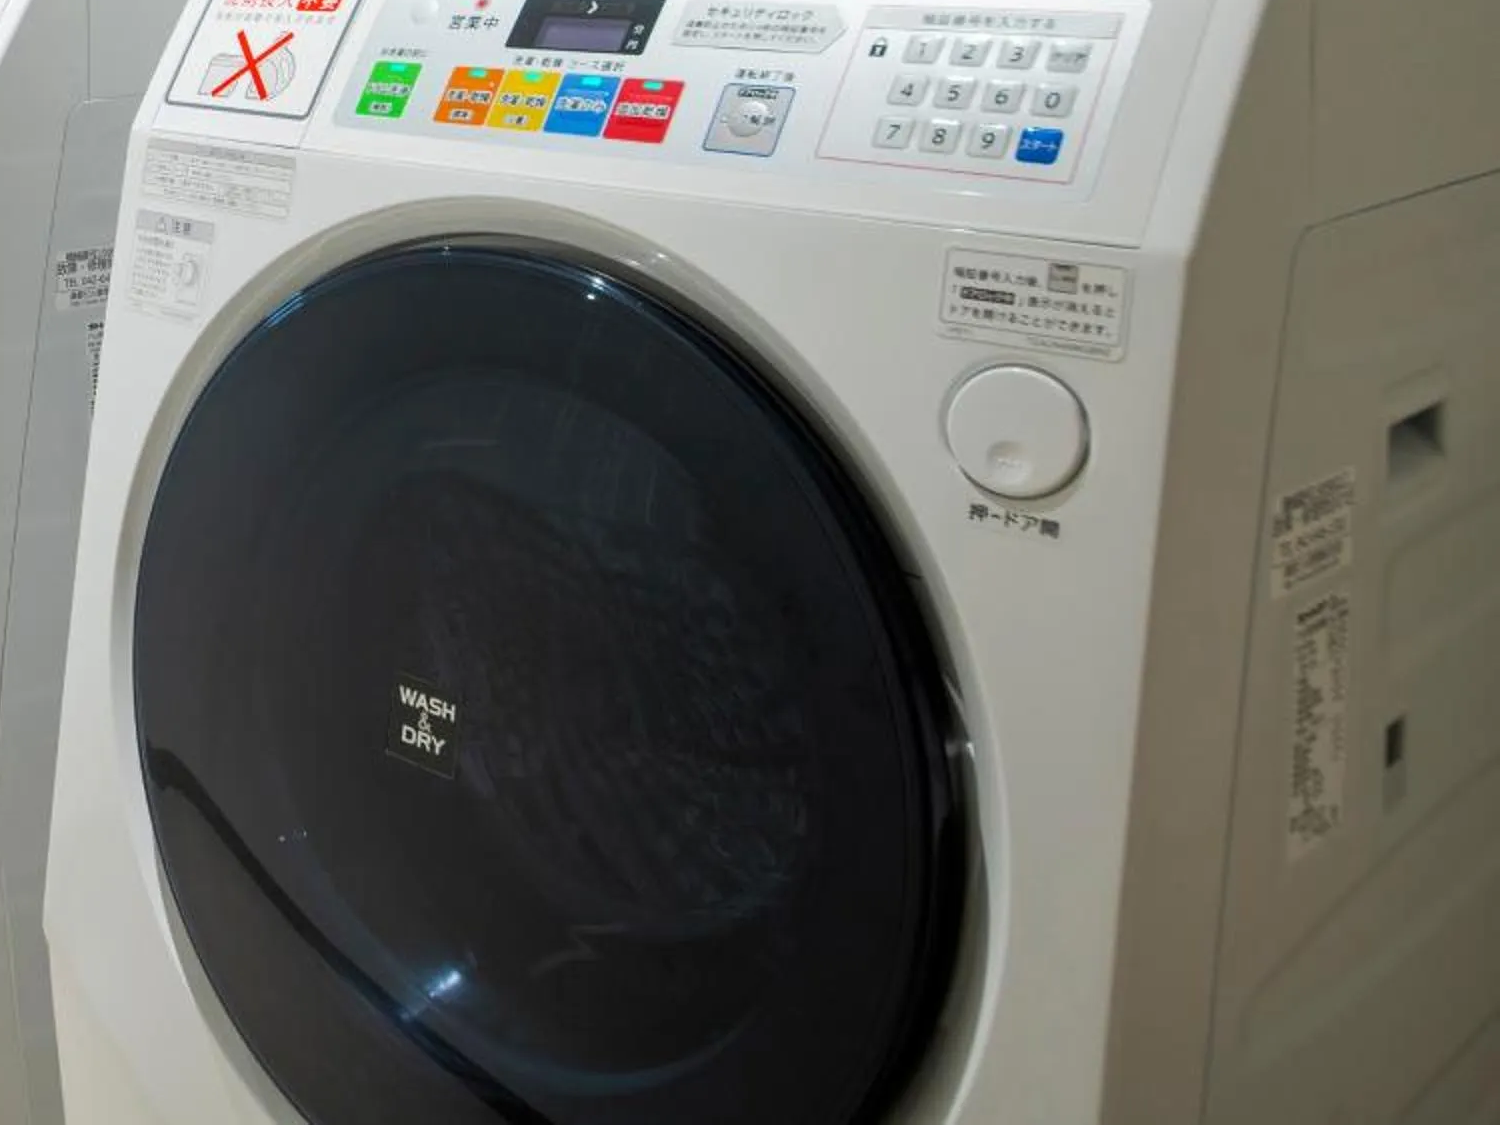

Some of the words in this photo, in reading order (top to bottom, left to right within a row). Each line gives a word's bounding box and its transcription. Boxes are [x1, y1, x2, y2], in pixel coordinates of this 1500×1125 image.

[449, 14, 500, 31] 営業中
[918, 42, 928, 56] 1
[962, 44, 977, 60] 2
[1009, 46, 1025, 62] 3
[900, 83, 914, 97] 4
[947, 84, 961, 102] 5
[994, 88, 1008, 105] 6
[1044, 92, 1061, 109] 0
[886, 124, 901, 140] 7
[931, 127, 947, 145] 8
[982, 131, 996, 149] 9
[399, 684, 456, 723] WASH
[401, 724, 446, 756] DRY
